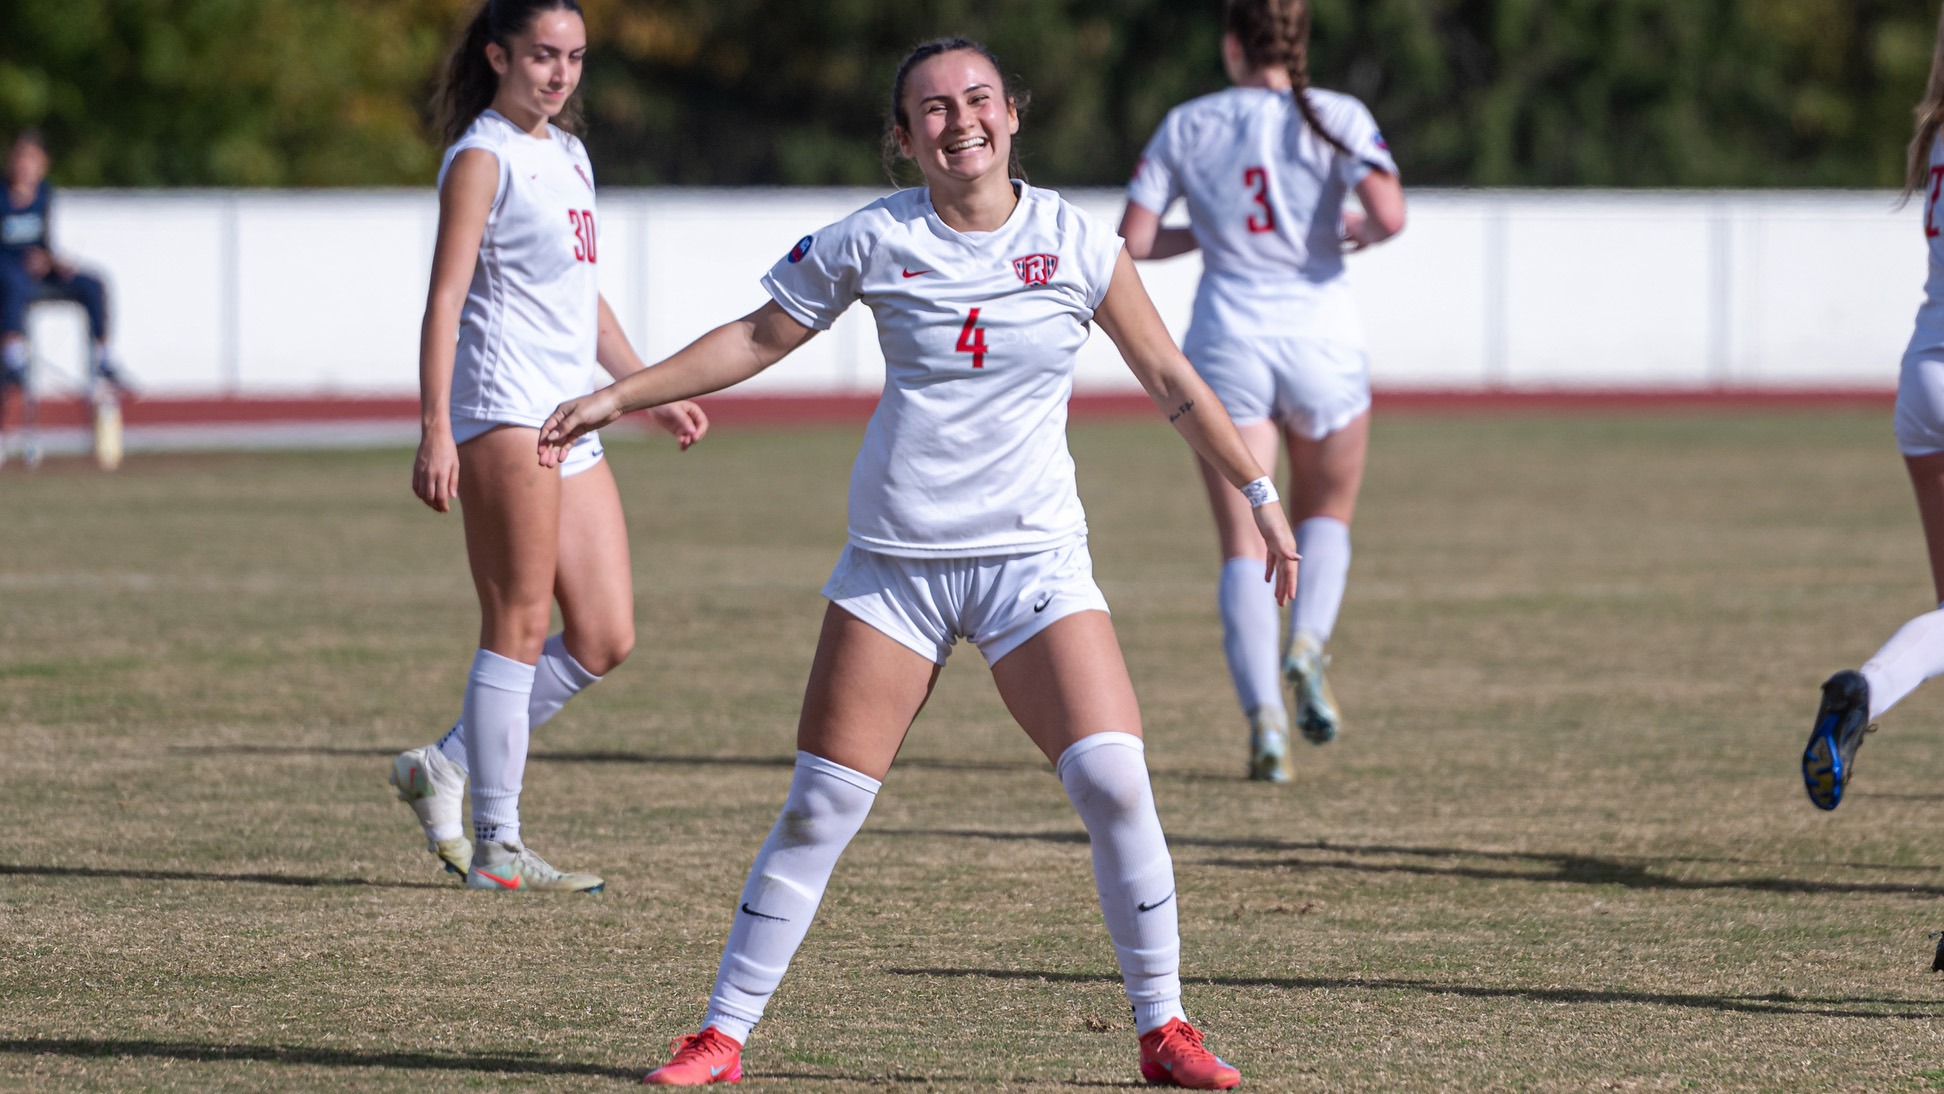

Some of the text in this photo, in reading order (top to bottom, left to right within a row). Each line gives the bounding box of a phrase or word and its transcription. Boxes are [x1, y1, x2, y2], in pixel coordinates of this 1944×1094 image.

[1244, 166, 1274, 234] 3
[568, 209, 597, 264] 30
[955, 307, 989, 369] 4
